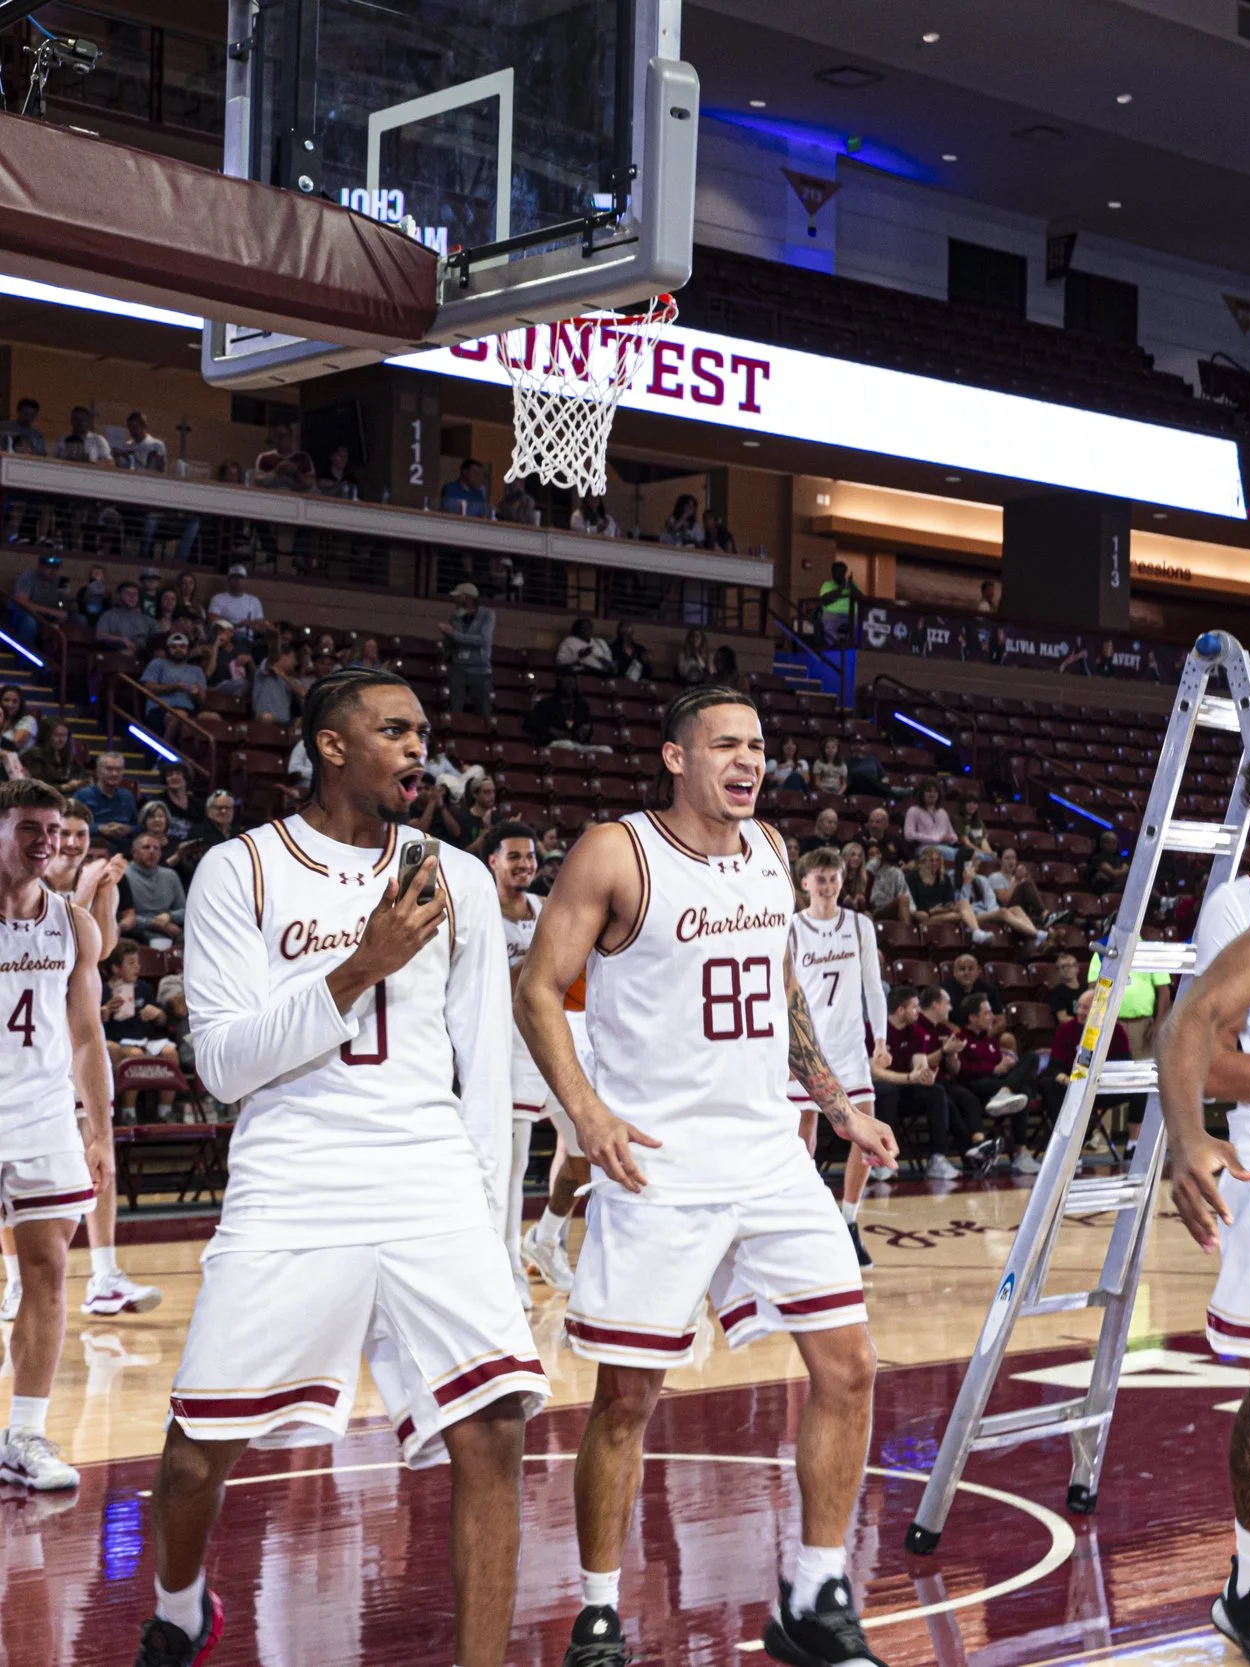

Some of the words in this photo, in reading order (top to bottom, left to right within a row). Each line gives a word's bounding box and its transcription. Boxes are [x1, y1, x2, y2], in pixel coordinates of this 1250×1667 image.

[410, 420, 423, 485] 112
[1111, 536, 1120, 588] 113
[280, 916, 366, 960] Charl
[676, 904, 787, 943] Charleston
[802, 949, 856, 968] Charleston
[702, 957, 774, 1041] 82
[822, 971, 840, 1007] 7
[7, 989, 36, 1047] 4
